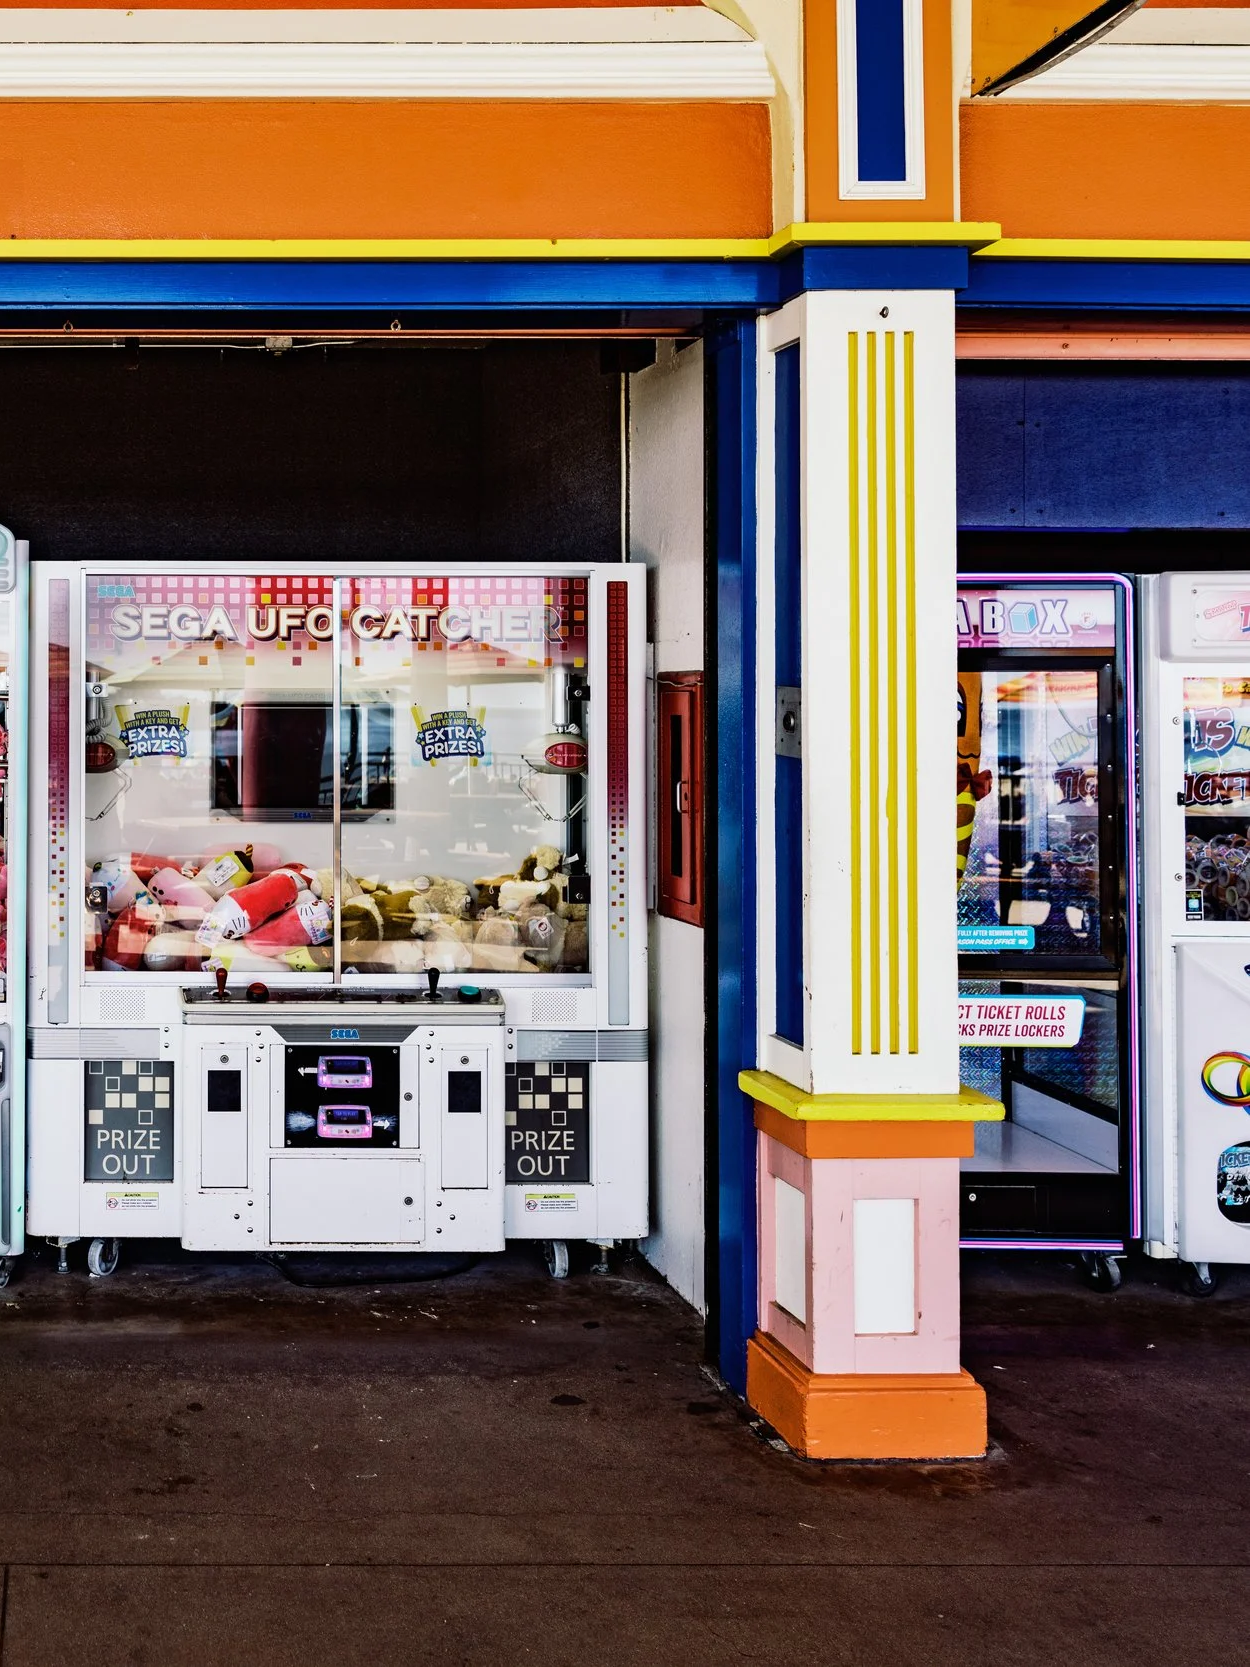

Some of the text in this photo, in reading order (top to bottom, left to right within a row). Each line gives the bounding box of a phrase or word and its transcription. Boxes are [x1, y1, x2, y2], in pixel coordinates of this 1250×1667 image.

[97, 585, 135, 598] SEGA
[111, 604, 239, 641] SEGA
[247, 605, 333, 641] UFO
[351, 605, 564, 642] CATCHER
[126, 720, 140, 728] WITH
[422, 721, 436, 730] WITH
[128, 725, 180, 742] EXTRA
[425, 726, 477, 744] EXTRA
[128, 739, 184, 756] PRIZES!
[425, 740, 481, 758] PRIZES!
[1053, 768, 1098, 802] TIC
[958, 1005, 1066, 1020] CT TICKET ROLLS
[331, 1029, 359, 1039] SEGA
[958, 1024, 1065, 1037] KS PRIZE LOCKERS
[97, 1129, 161, 1149] PRIZE
[511, 1131, 575, 1151] PRIZE
[102, 1154, 156, 1175] OUT
[517, 1155, 570, 1176] OUT
[1220, 1152, 1250, 1168] ICKE
